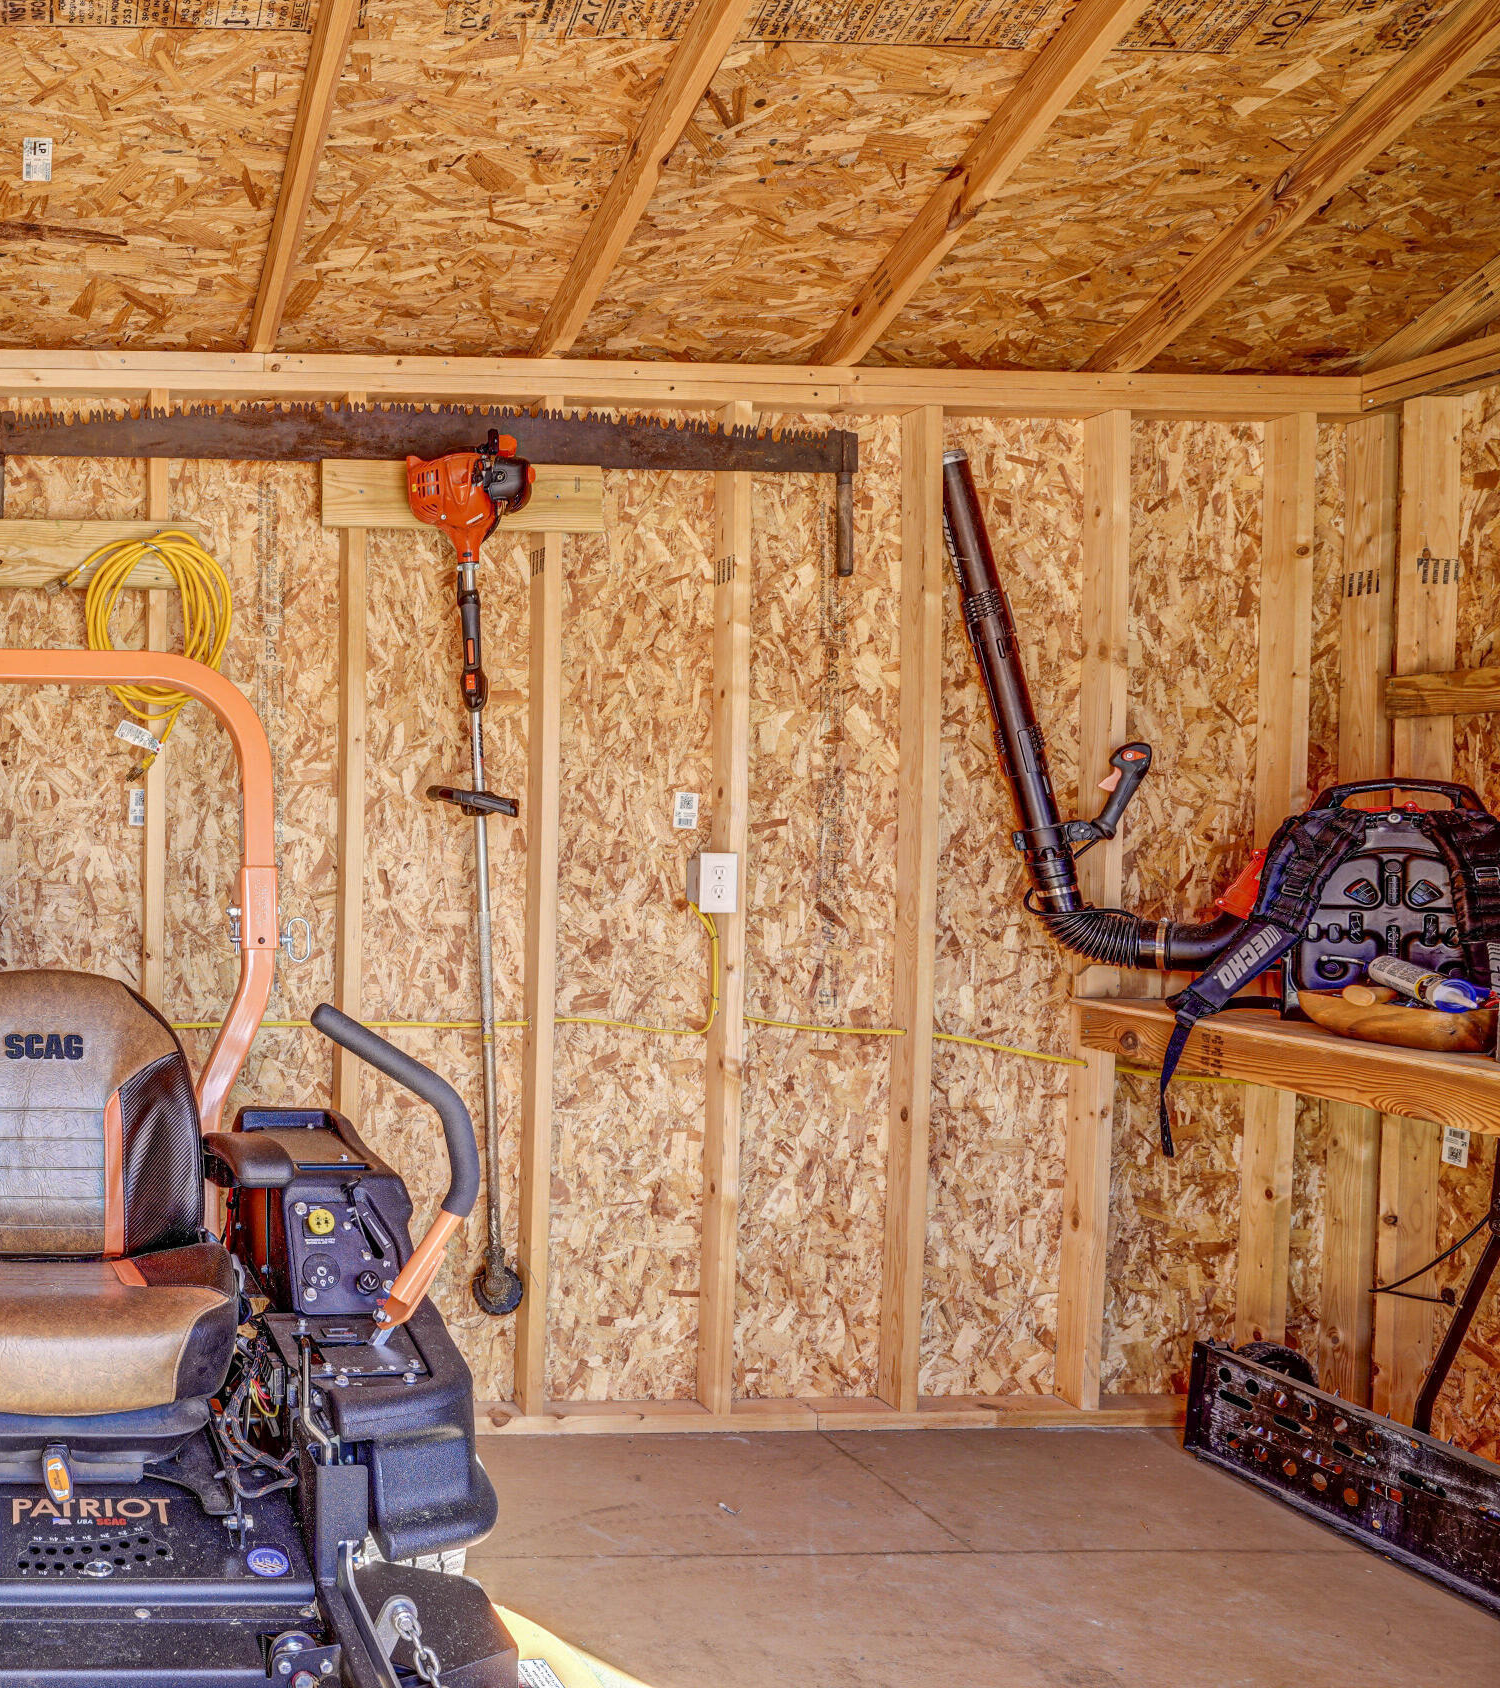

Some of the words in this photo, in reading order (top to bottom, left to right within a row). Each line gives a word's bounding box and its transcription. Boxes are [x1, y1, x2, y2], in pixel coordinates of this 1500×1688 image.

[1217, 935, 1270, 989] ECHO
[4, 1034, 84, 1060] SCAG
[12, 1498, 171, 1526] PATRIOT
[96, 1518, 128, 1526] SCAG
